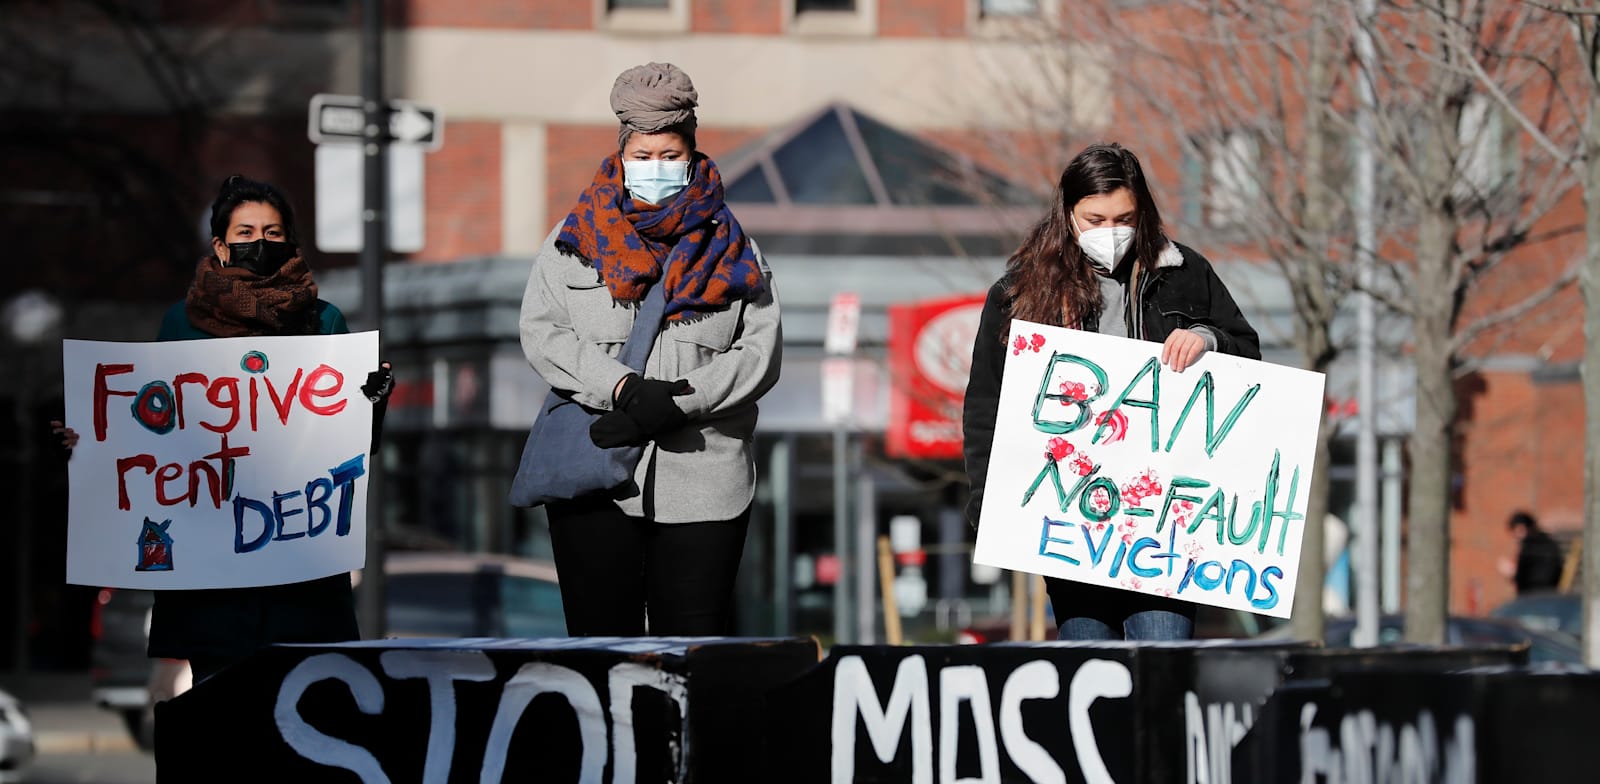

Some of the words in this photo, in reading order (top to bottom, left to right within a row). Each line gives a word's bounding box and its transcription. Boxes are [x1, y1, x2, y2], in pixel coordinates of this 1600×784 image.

[93, 351, 347, 441] Forgive
[1031, 350, 1261, 459] BAN
[117, 432, 250, 511] rent
[233, 453, 365, 553] DEBT
